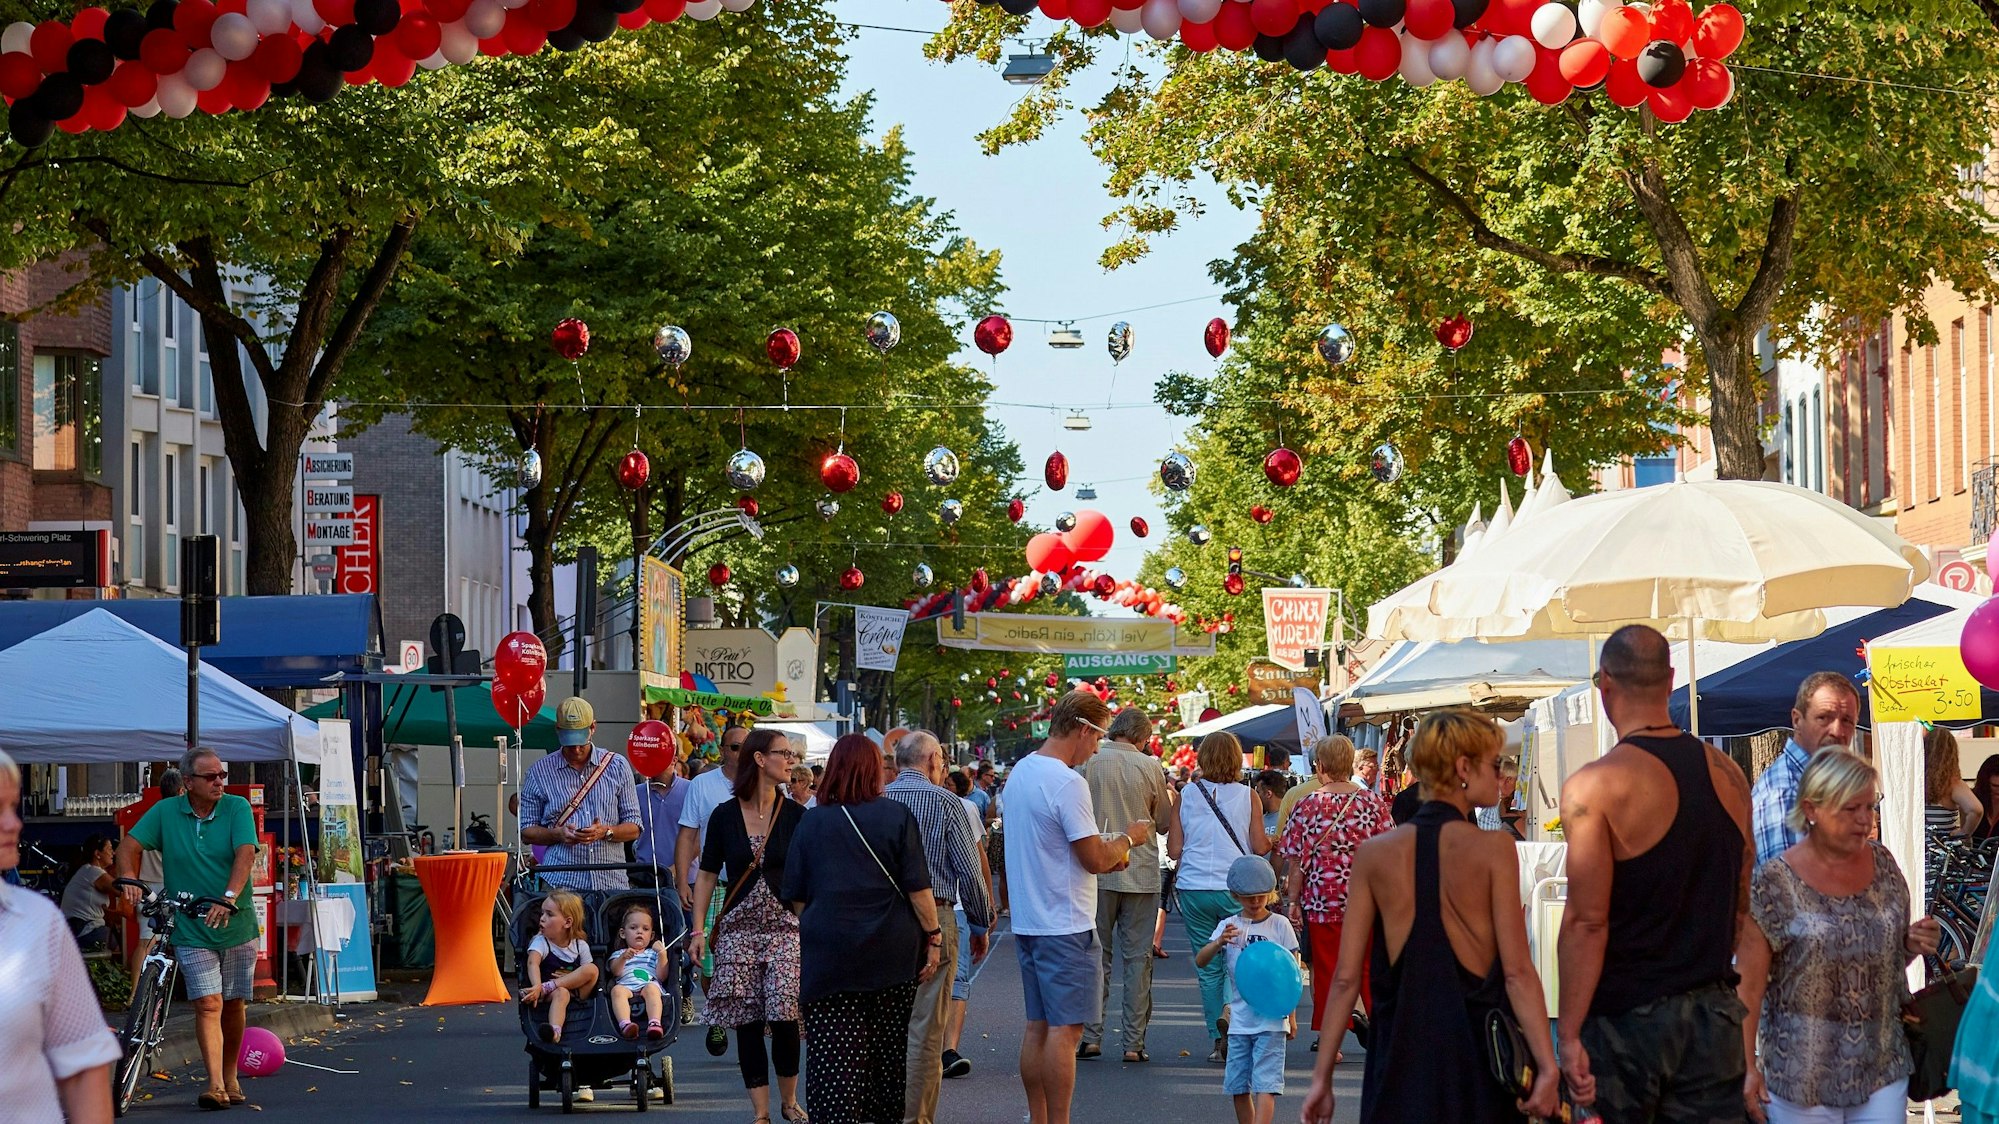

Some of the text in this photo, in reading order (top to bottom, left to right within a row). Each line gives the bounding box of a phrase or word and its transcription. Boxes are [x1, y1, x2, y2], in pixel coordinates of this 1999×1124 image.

[306, 457, 351, 473] ABSICHERUNG
[307, 490, 350, 506] BERATUNG
[51, 533, 72, 542] Platz
[307, 523, 350, 540] MONTAGE
[1271, 599, 1321, 623] CHINA
[858, 620, 902, 650] Crêpes
[1271, 623, 1321, 646] NUDELN
[407, 653, 416, 666] 30
[710, 646, 740, 661] Petit
[1067, 655, 1149, 669] AUSGANG
[695, 661, 754, 680] BISTRO
[1880, 674, 1949, 690] Obstsalat
[684, 693, 717, 706] Little
[723, 696, 753, 710] Duck
[633, 735, 660, 743] Sparkasse
